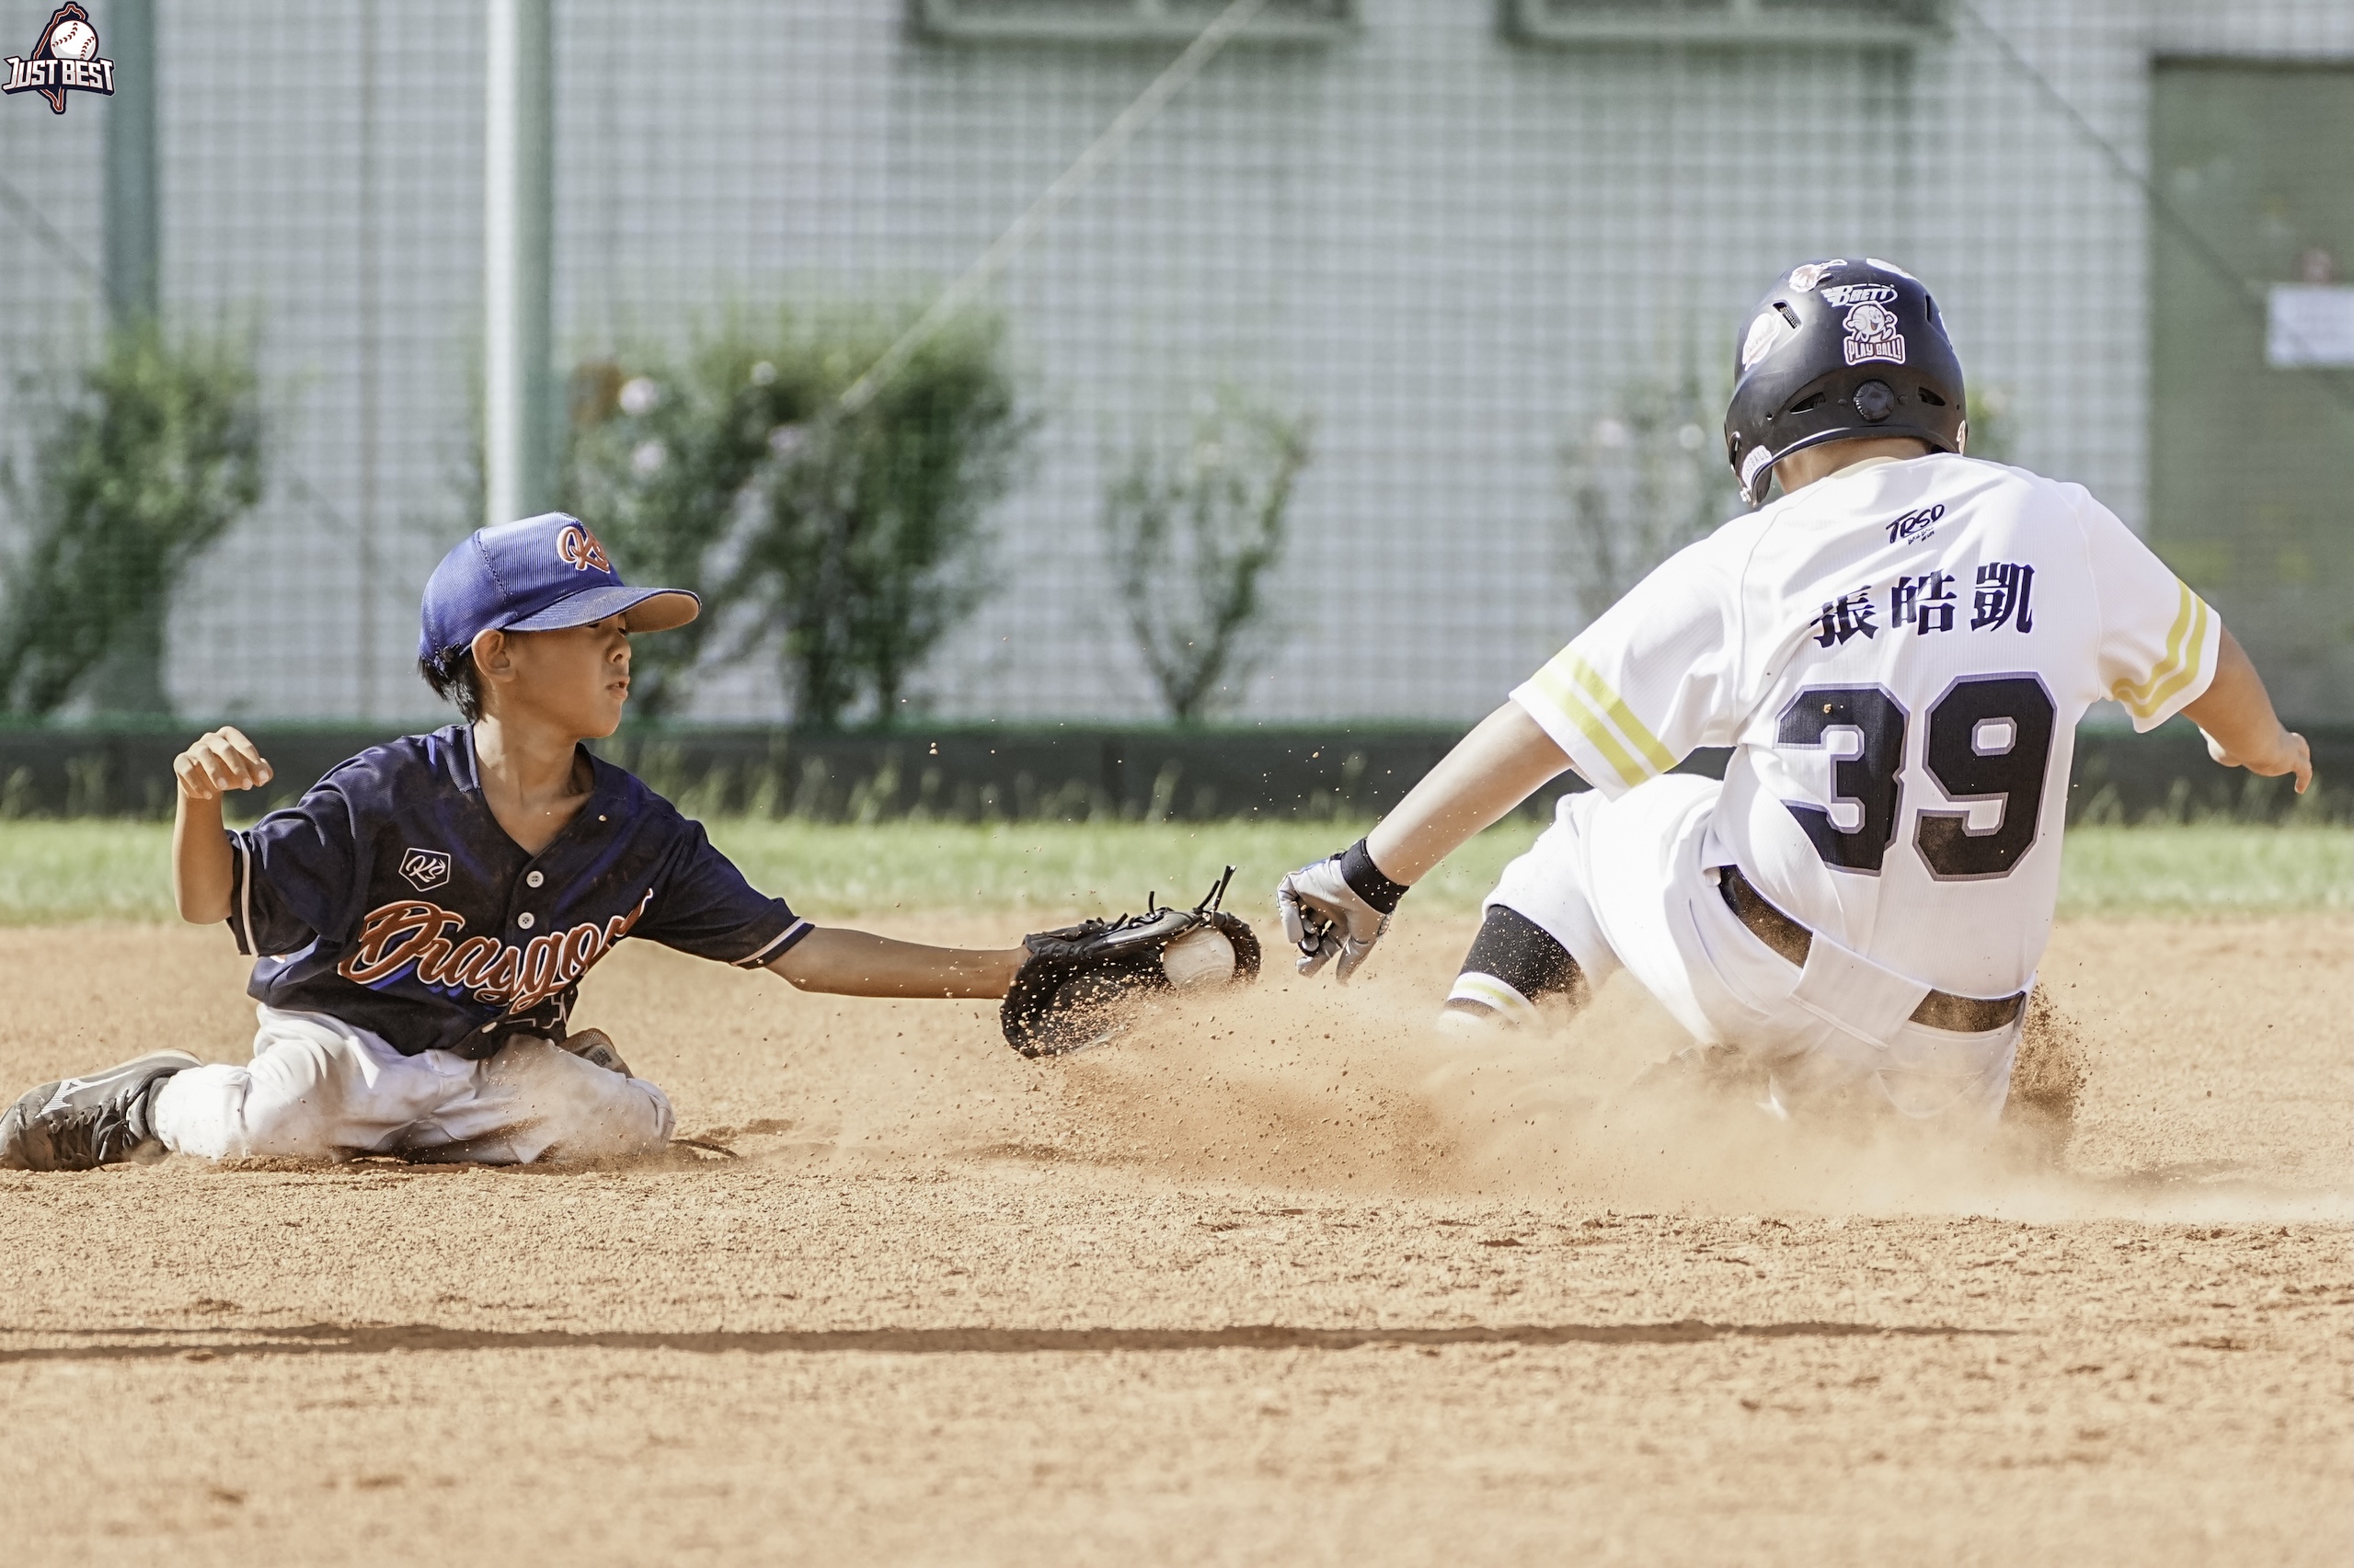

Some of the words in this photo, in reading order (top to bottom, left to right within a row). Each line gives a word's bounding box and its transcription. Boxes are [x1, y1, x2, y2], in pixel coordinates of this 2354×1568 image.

[1847, 339, 1874, 362] PLAY
[1876, 338, 1902, 360] BALL!
[1886, 504, 1945, 544] TRSD
[1773, 671, 2058, 882] 39
